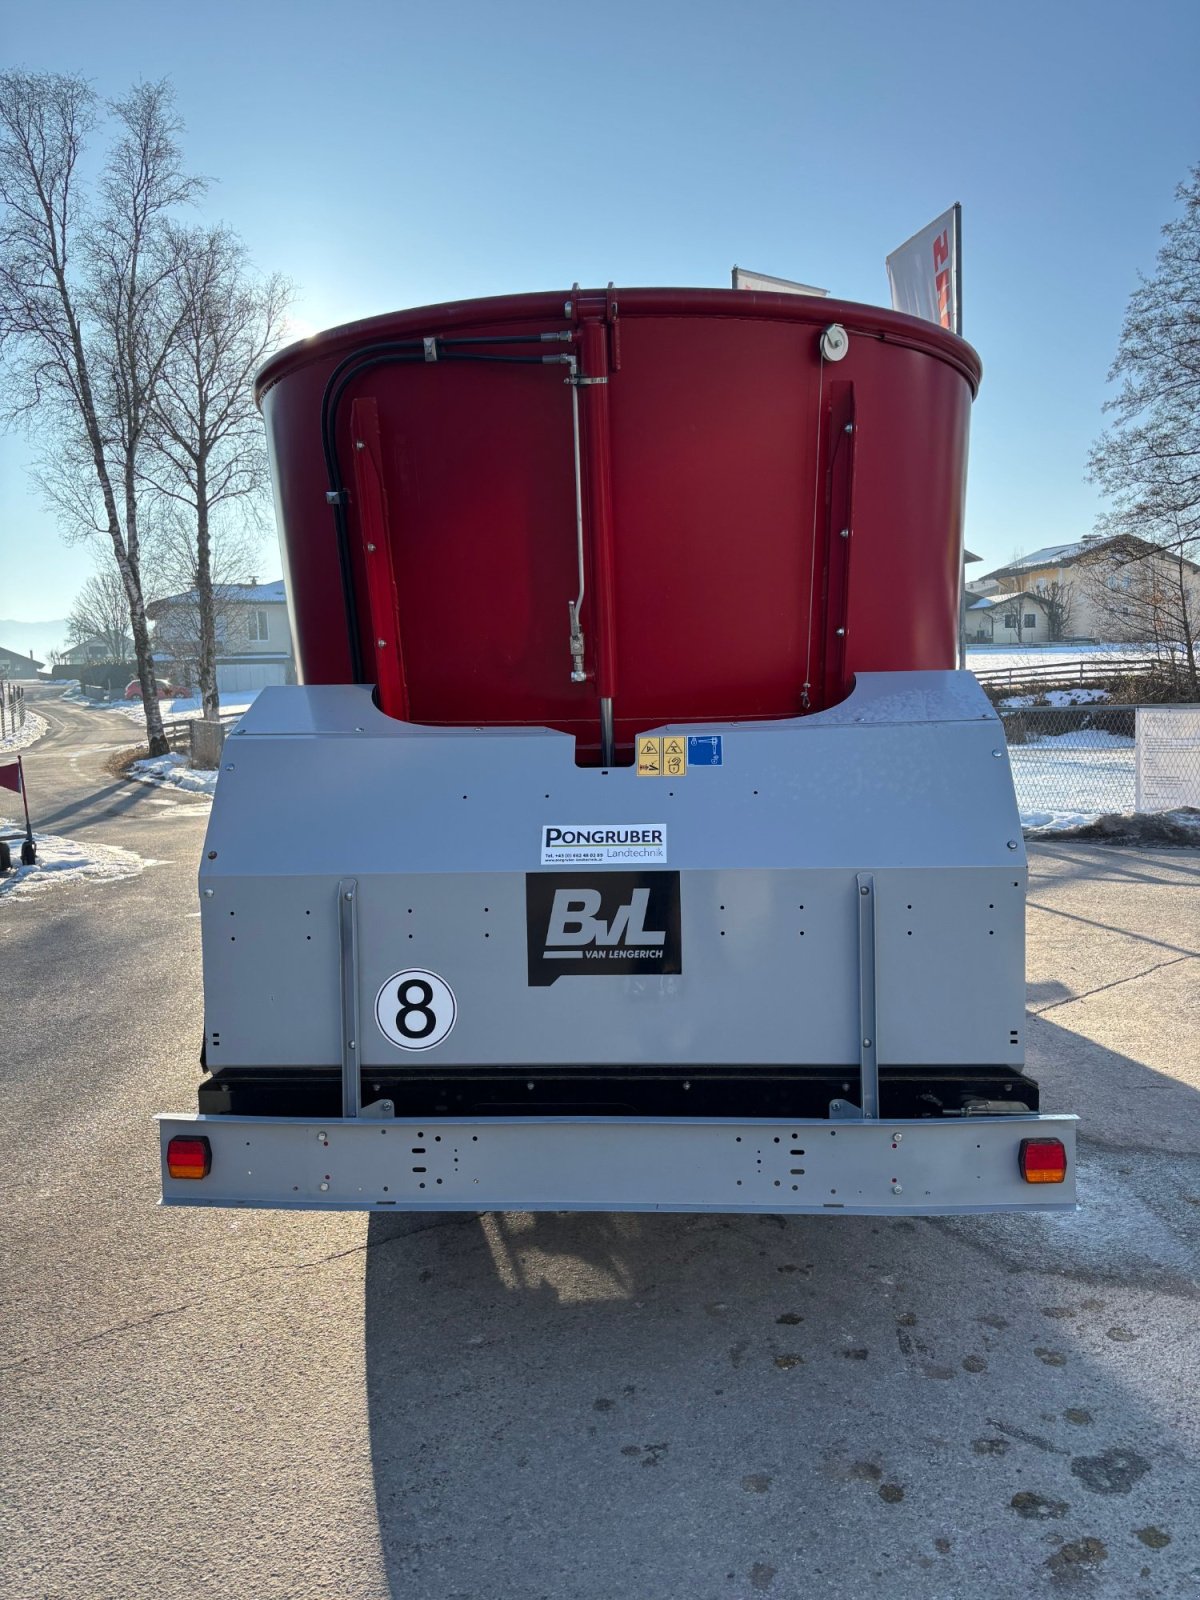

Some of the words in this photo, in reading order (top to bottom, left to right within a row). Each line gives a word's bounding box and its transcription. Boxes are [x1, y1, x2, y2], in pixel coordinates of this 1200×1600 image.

[546, 828, 663, 847] PONGRUBER
[606, 848, 664, 858] Landtechnik
[585, 951, 607, 959] VAN
[608, 950, 663, 959] LENGERICH
[395, 979, 436, 1039] 8
